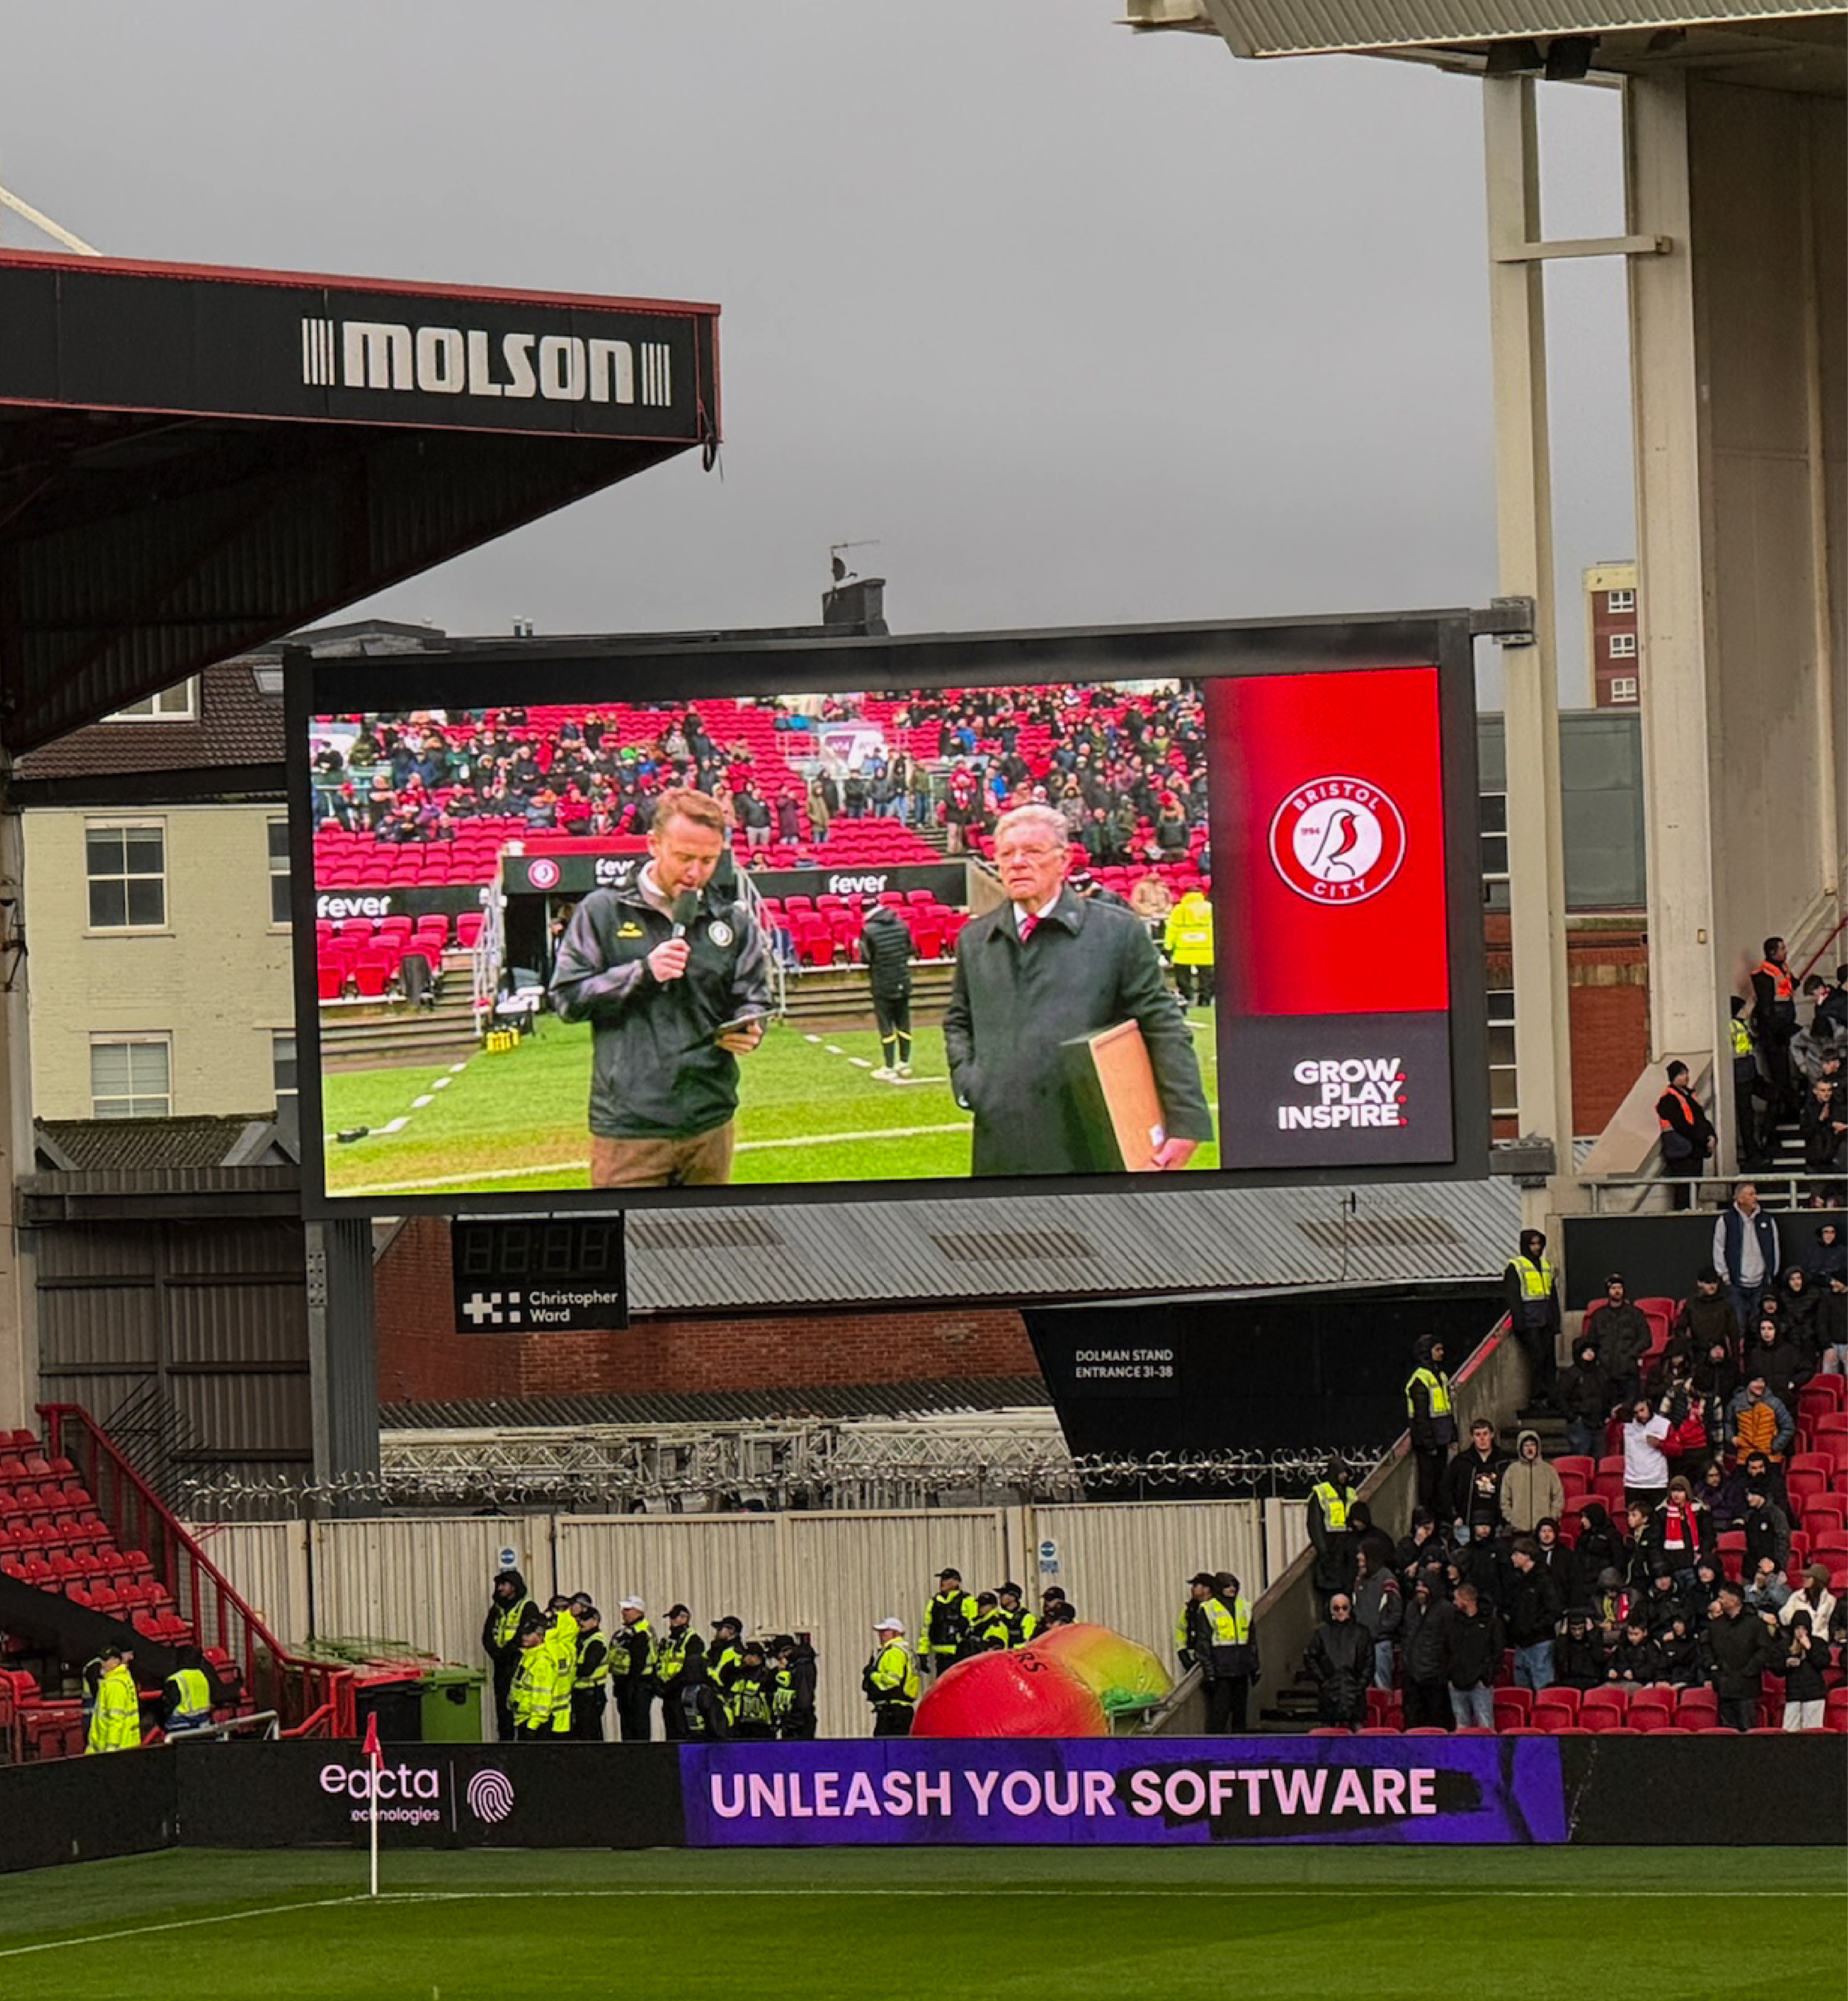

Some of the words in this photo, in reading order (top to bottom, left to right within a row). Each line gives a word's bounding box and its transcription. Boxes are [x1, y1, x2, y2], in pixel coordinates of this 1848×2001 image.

[342, 321, 634, 404] MOLSON
[1293, 783, 1380, 811] BRISTOL
[829, 874, 888, 894] fever
[1313, 879, 1366, 897] CITY
[316, 895, 393, 918] fever
[1294, 1058, 1407, 1084] GROW.
[1322, 1081, 1407, 1105] PLAY.
[1278, 1104, 1407, 1129] INSPIRE.
[529, 1290, 618, 1308] Christopher
[529, 1308, 571, 1323] Ward
[1076, 1349, 1130, 1362] DOLMAN
[1132, 1348, 1174, 1361] STAND
[1076, 1366, 1141, 1378] ENTRANCE
[710, 1771, 951, 1818] UNLEASH
[964, 1770, 1116, 1816] YOUR
[1130, 1768, 1437, 1815] SOFTWARE
